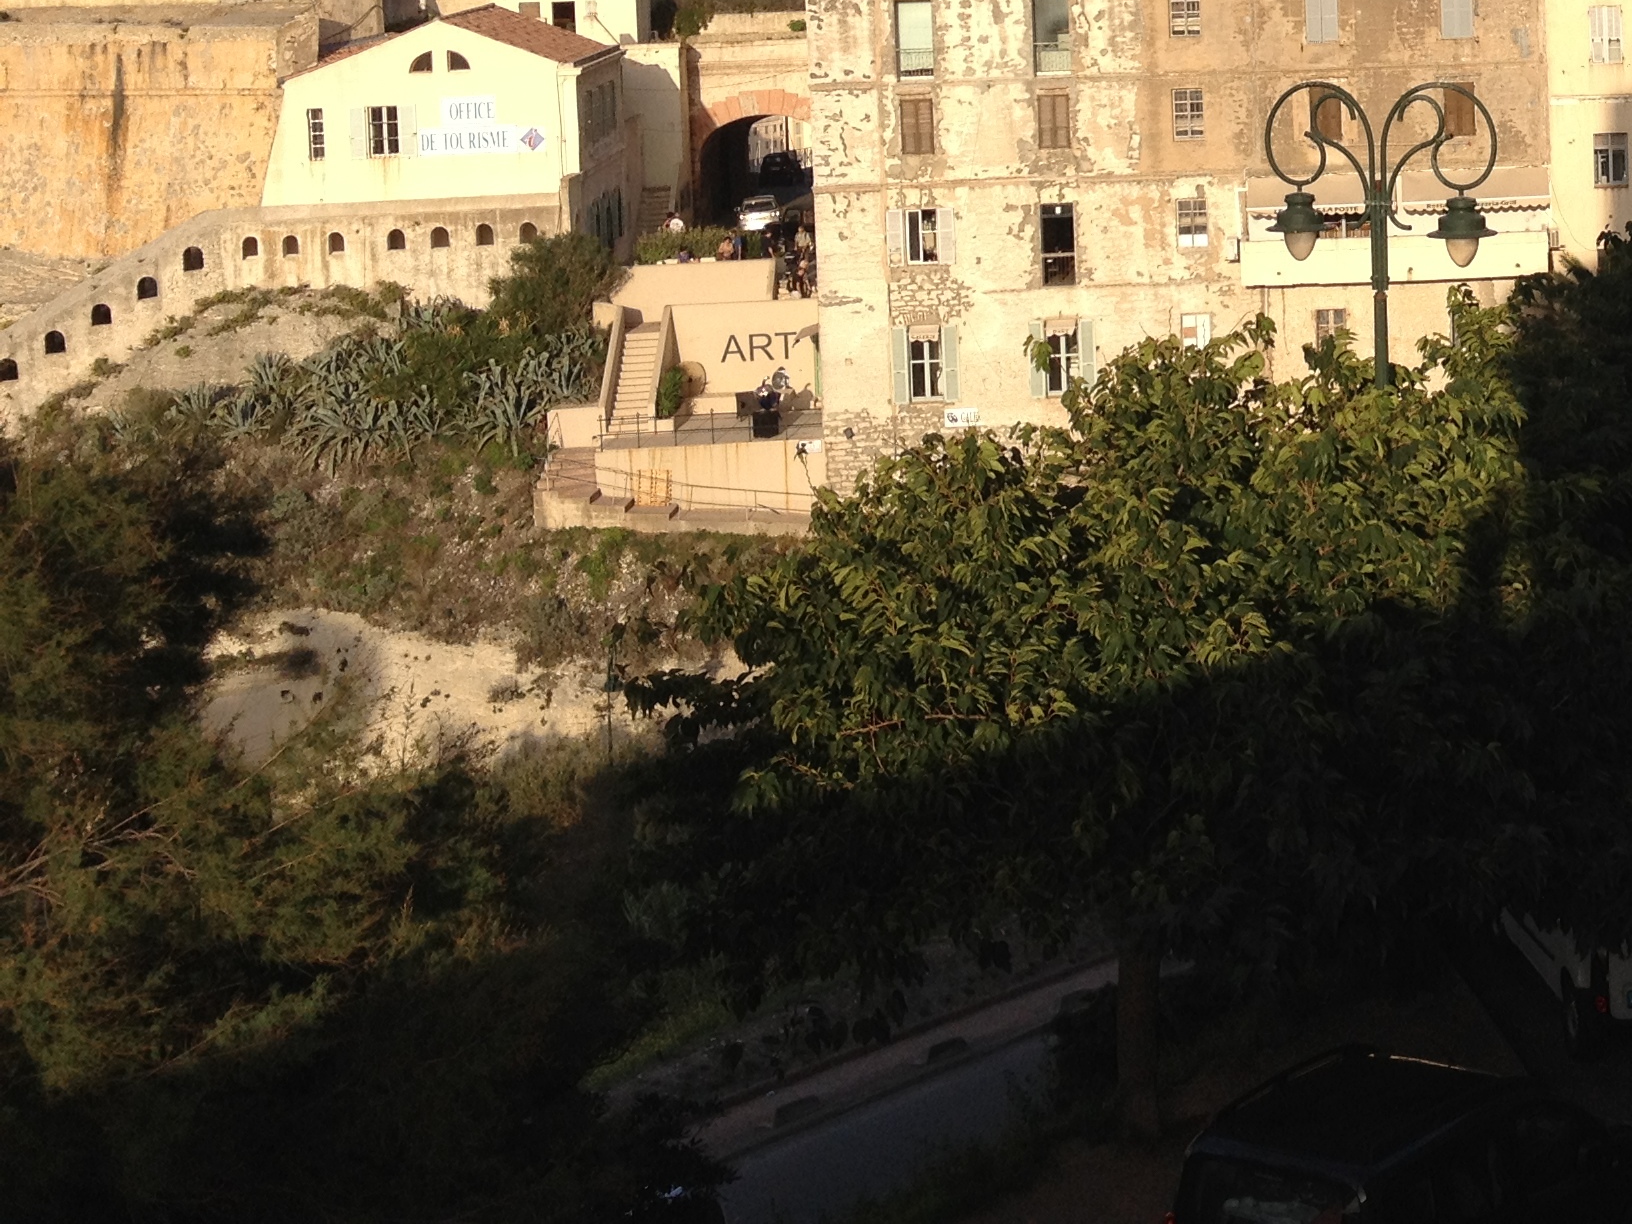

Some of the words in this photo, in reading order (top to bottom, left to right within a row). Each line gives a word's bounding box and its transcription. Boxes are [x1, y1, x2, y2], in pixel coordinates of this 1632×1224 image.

[449, 101, 496, 120] OFFICE
[421, 133, 438, 151] DE
[443, 130, 509, 150] TOURISME
[720, 331, 798, 363] ART
